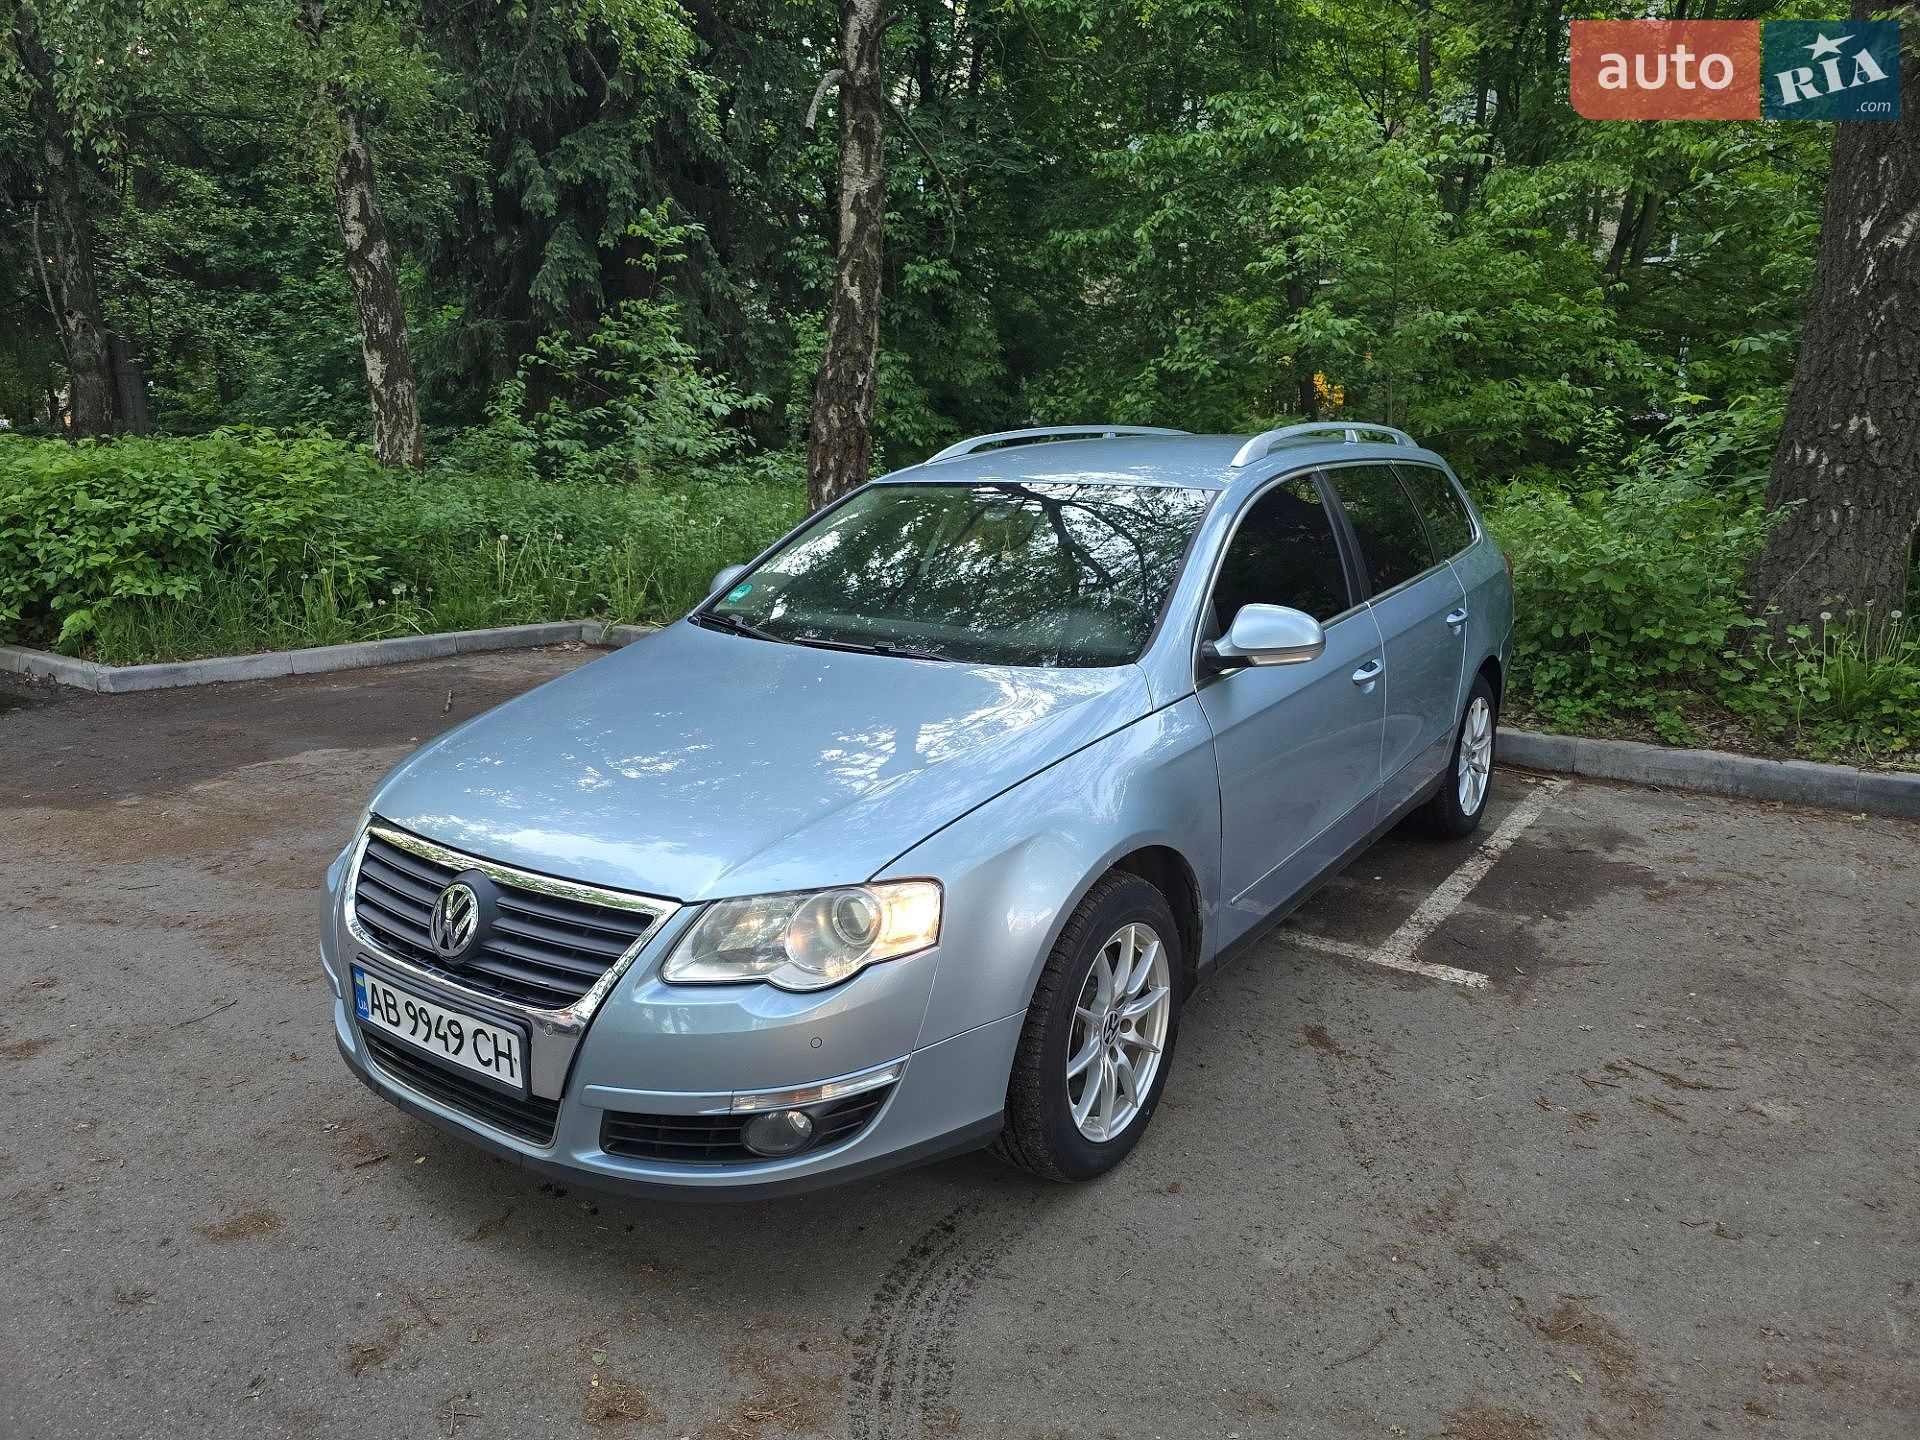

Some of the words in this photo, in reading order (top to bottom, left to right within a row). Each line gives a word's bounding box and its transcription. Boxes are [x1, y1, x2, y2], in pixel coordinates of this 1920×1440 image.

[371, 982, 400, 1028] AB
[404, 1000, 465, 1056] 9949
[472, 1028, 516, 1078] CH
